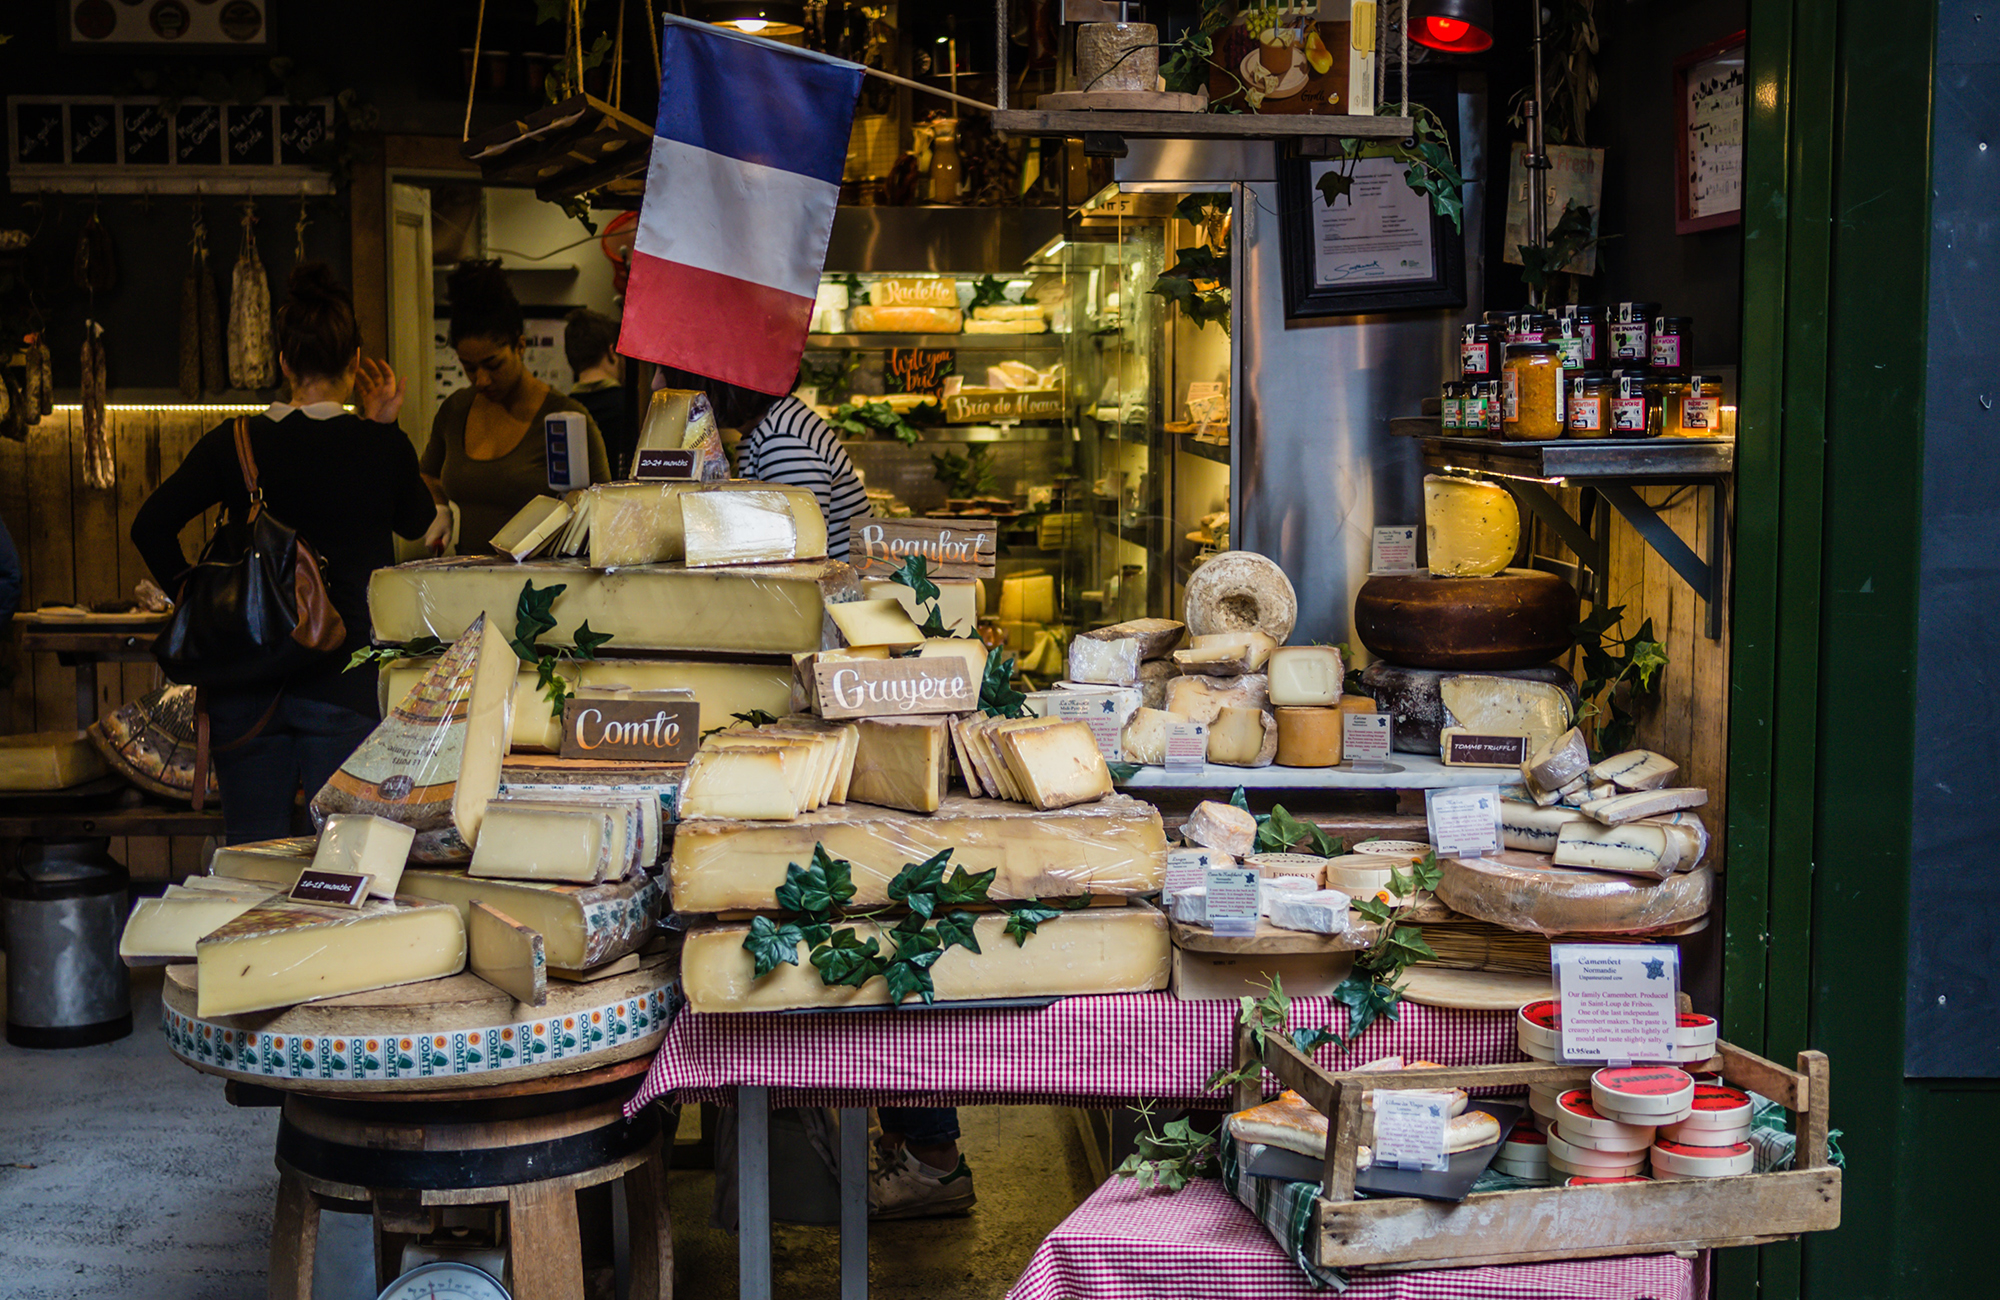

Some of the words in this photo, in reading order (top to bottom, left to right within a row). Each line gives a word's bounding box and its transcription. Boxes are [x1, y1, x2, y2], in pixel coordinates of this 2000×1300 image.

[1557, 151, 1594, 174] Fresh
[1121, 201, 1130, 211] 5
[883, 280, 951, 305] Raclette
[887, 348, 922, 376] Will
[927, 350, 954, 377] you
[907, 367, 939, 392] brie
[954, 396, 993, 420] Brie
[996, 396, 1011, 413] de
[662, 458, 689, 466] months
[855, 525, 990, 571] Beaufort
[833, 669, 967, 711] Gruyère
[301, 880, 325, 889] 16-18
[323, 884, 353, 892] months
[1579, 956, 1622, 966] Camembert
[1582, 991, 1601, 1000] family
[1588, 1000, 1622, 1008] Saint-Loup
[263, 1035, 274, 1075] COMTÉ
[292, 1037, 301, 1077] COMTÉ
[387, 1038, 399, 1079] COMTÉ
[420, 1036, 432, 1076] COMTÉ
[455, 1033, 466, 1073] COMTÉ
[489, 1029, 499, 1069] COMTÉ
[521, 1025, 530, 1064] COMTÉ
[552, 1019, 561, 1059] COMTÉ
[321, 1039, 332, 1079] COMTÉ
[353, 1039, 365, 1079] COMTÉ
